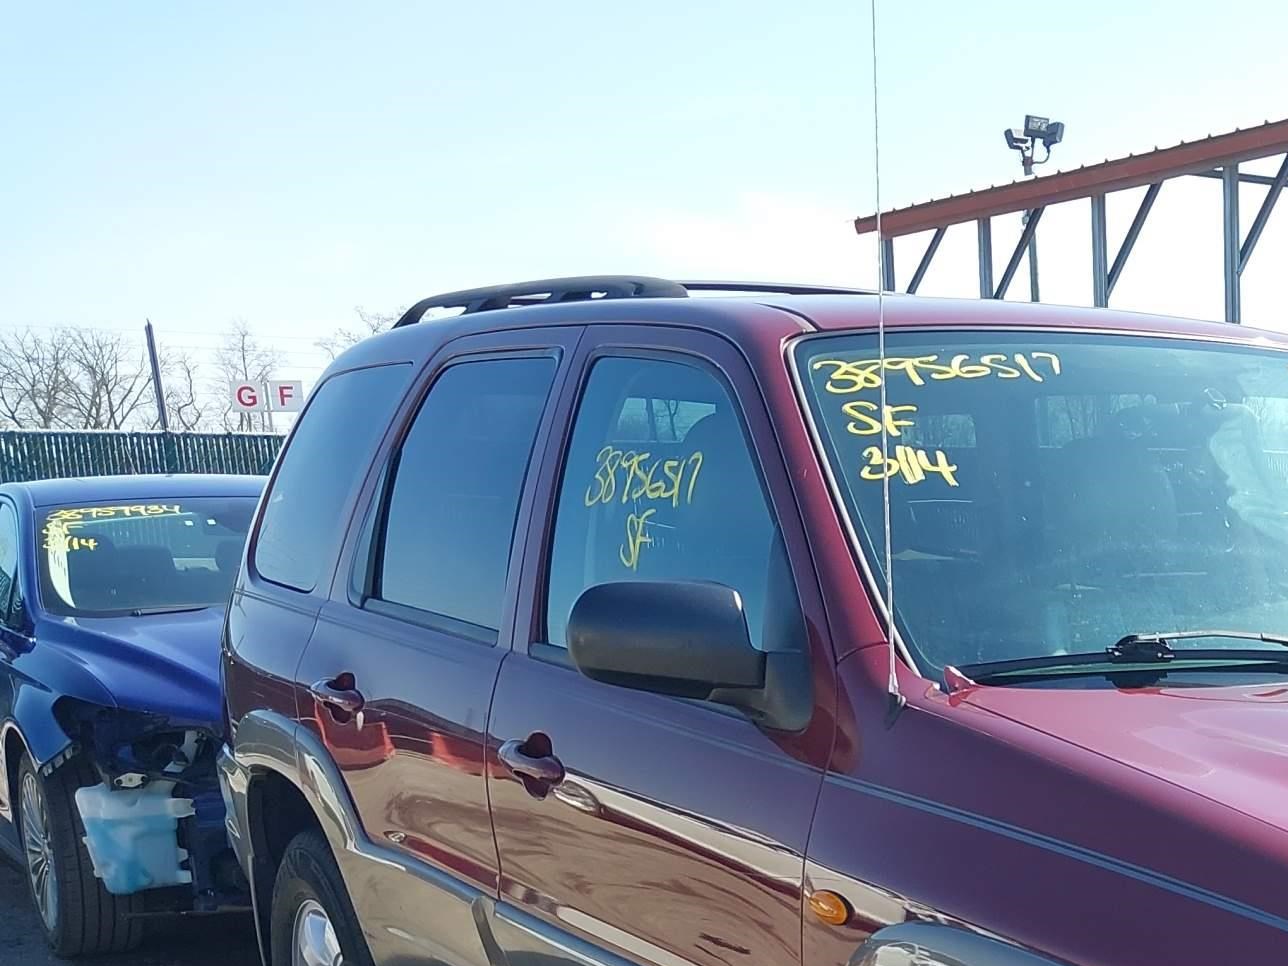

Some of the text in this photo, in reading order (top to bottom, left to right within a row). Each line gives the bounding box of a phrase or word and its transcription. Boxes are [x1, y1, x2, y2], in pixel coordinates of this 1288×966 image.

[813, 353, 1061, 394] 38956517
[237, 386, 257, 407] G
[279, 386, 293, 406] F
[841, 401, 917, 437] SF
[584, 446, 703, 508] 38956517
